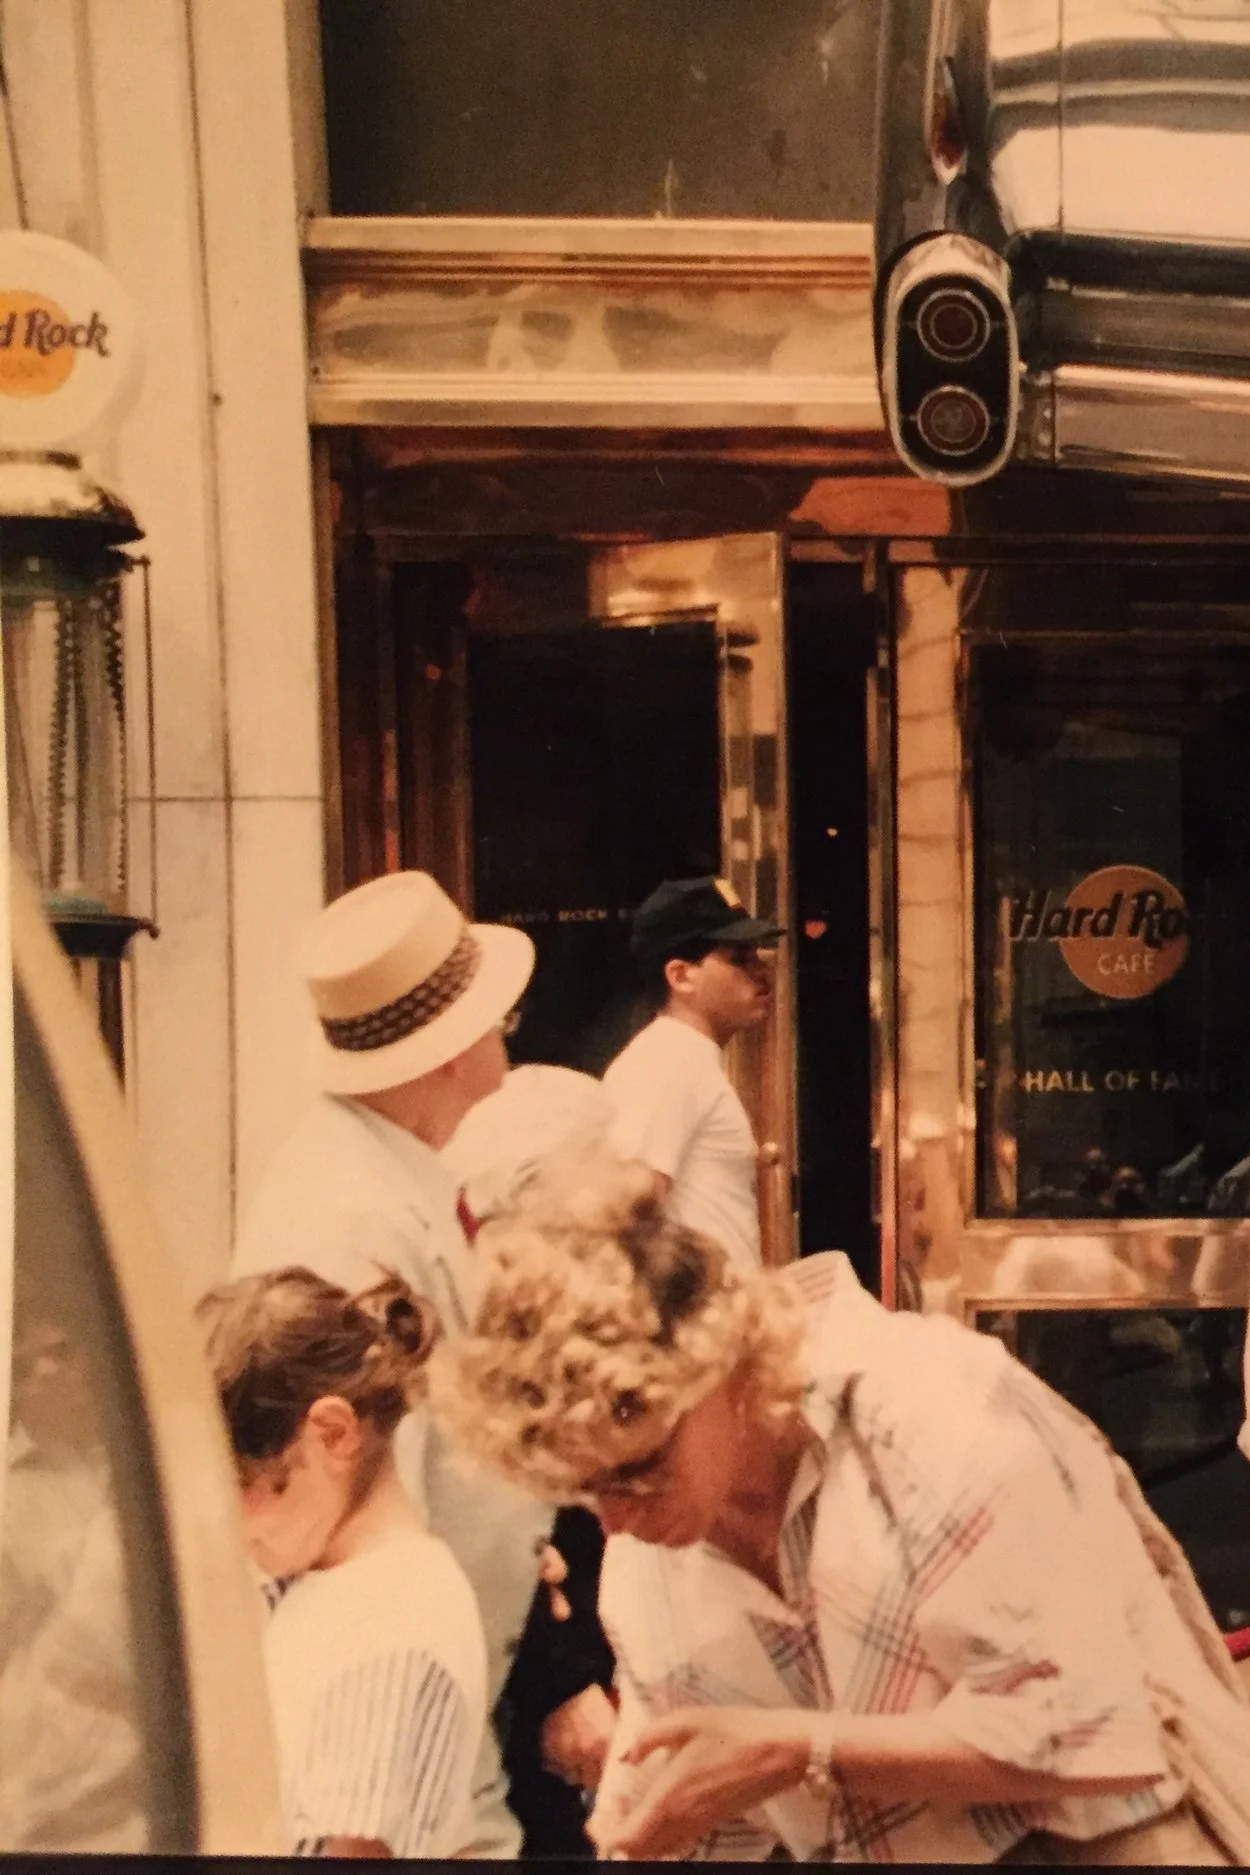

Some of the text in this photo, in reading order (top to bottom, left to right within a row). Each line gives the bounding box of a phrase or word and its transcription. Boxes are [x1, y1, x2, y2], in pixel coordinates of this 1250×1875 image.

[24, 308, 110, 357] Rock
[1008, 888, 1124, 942] Hard
[1096, 953, 1156, 976] CAFE
[1023, 1070, 1095, 1093] HALL
[1104, 1070, 1141, 1092] OF
